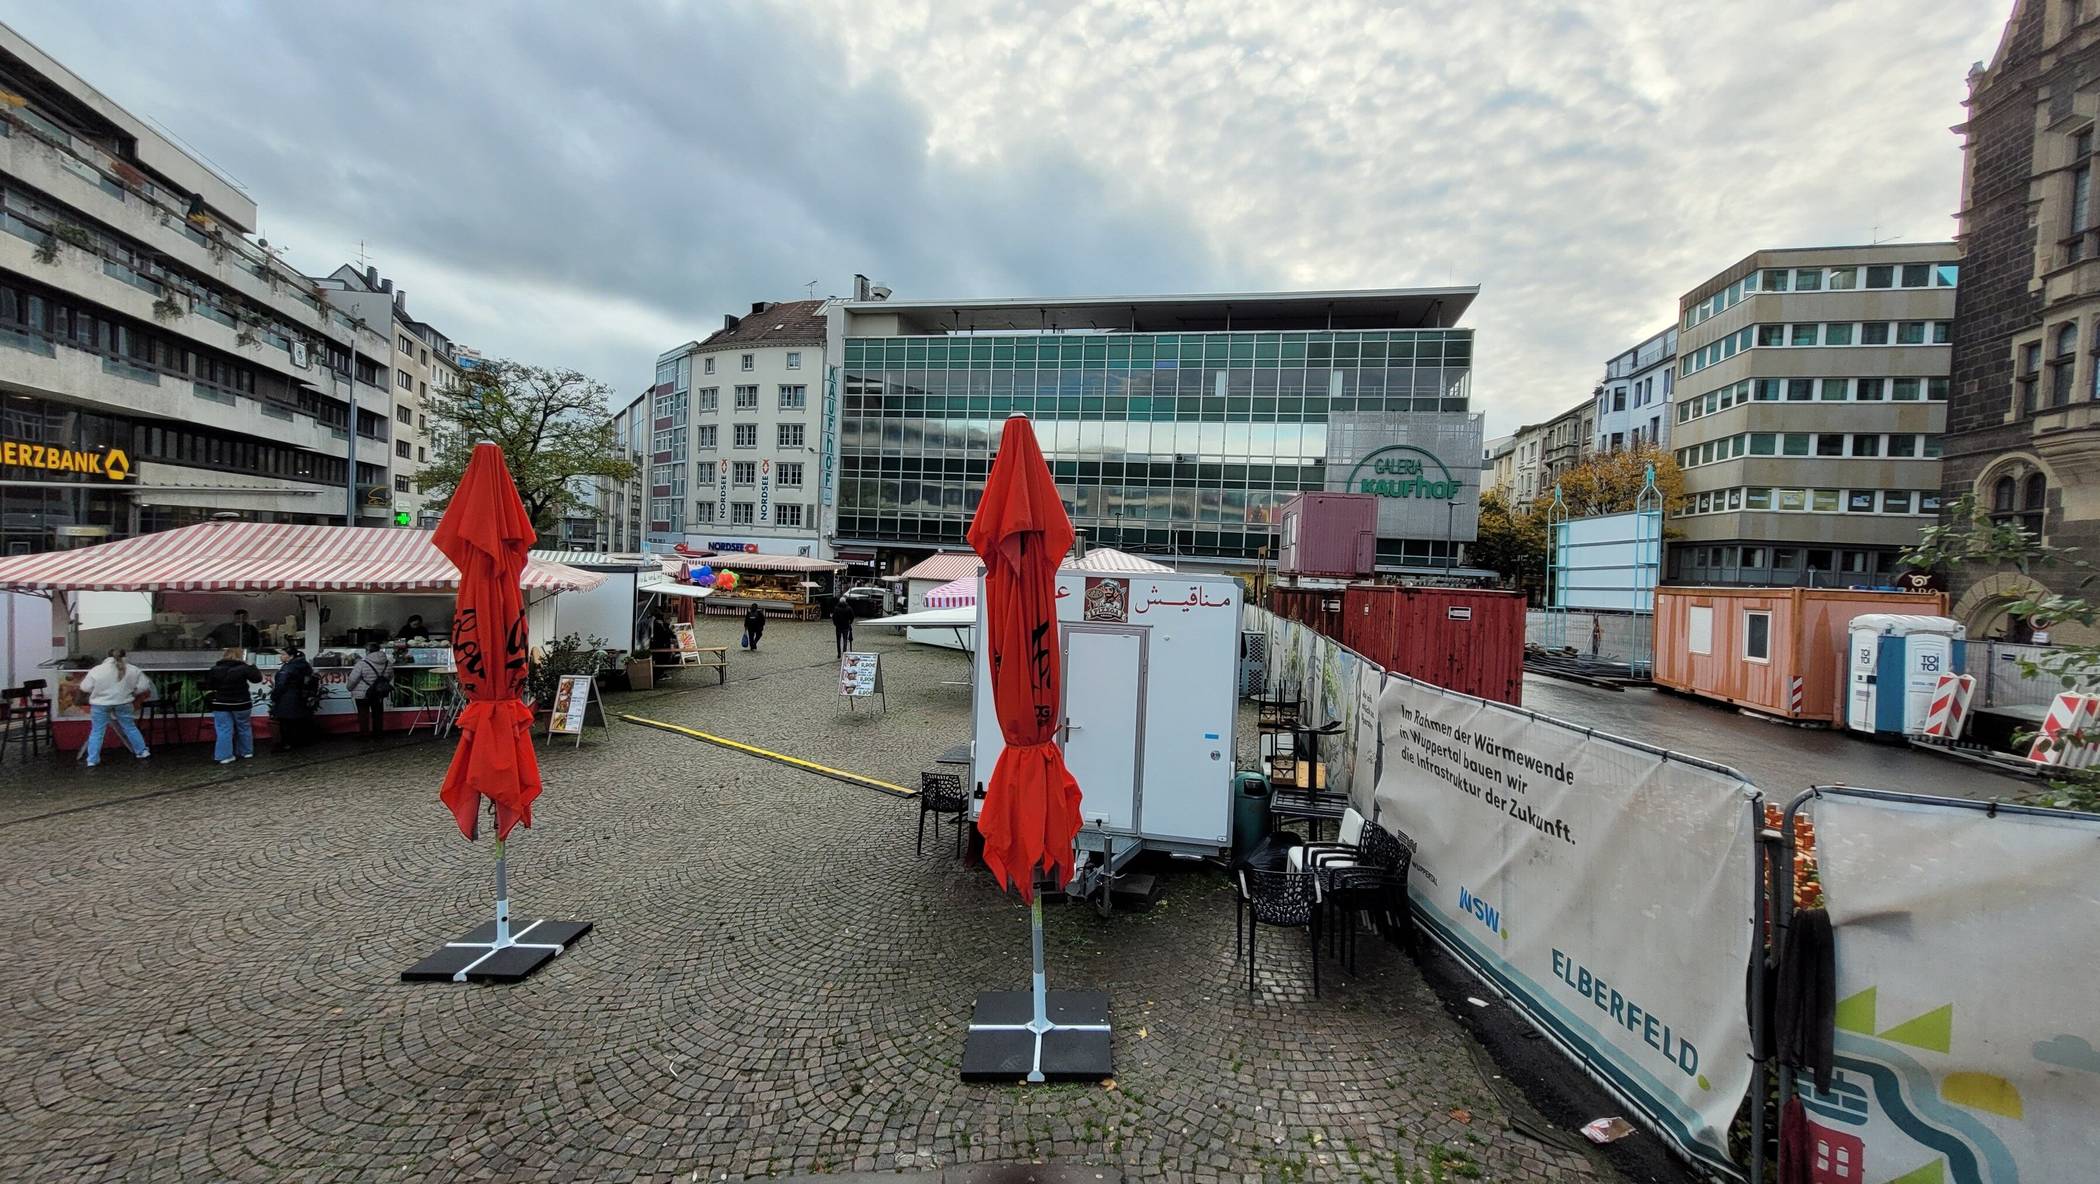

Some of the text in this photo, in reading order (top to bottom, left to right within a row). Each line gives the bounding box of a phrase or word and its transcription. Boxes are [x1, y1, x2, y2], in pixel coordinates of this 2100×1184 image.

[0, 441, 101, 473] ERZBANK
[1374, 458, 1424, 475] GALERIA
[760, 475, 769, 520] NORDSEE
[708, 542, 745, 552] NORDSEE
[1921, 655, 1940, 664] TOI
[1921, 663, 1939, 672] TOI
[1399, 725, 1529, 795] in Wuppertal bauen wir
[1401, 704, 1413, 721] Im
[1413, 709, 1453, 737] Rahmen
[1454, 725, 1472, 745] der
[1474, 732, 1575, 785] Wärmewende
[1401, 745, 1577, 846] die Infrastruktur der Zukunft.
